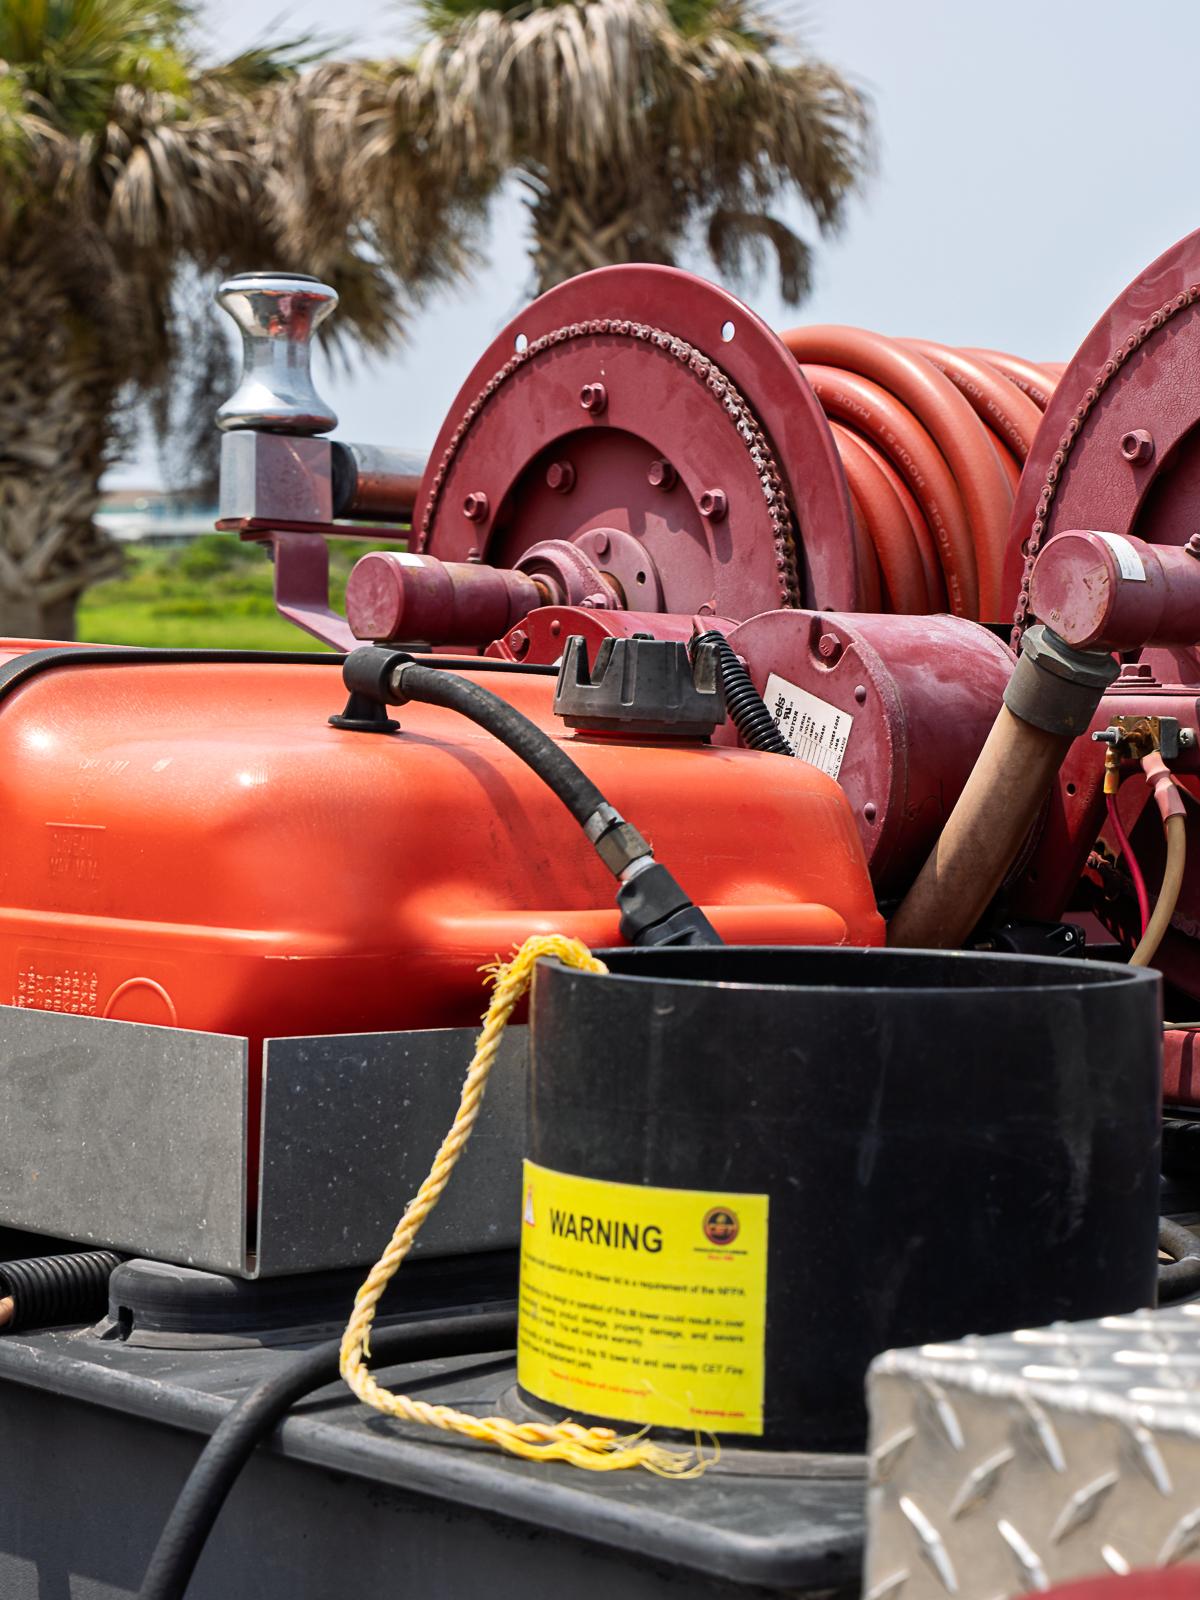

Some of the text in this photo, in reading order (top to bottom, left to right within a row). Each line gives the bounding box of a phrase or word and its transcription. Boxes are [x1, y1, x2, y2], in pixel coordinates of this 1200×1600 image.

[833, 390, 872, 421] MADE
[788, 710, 799, 739] MOTOR
[819, 725, 827, 744] PHASE
[549, 1208, 663, 1254] WARNING
